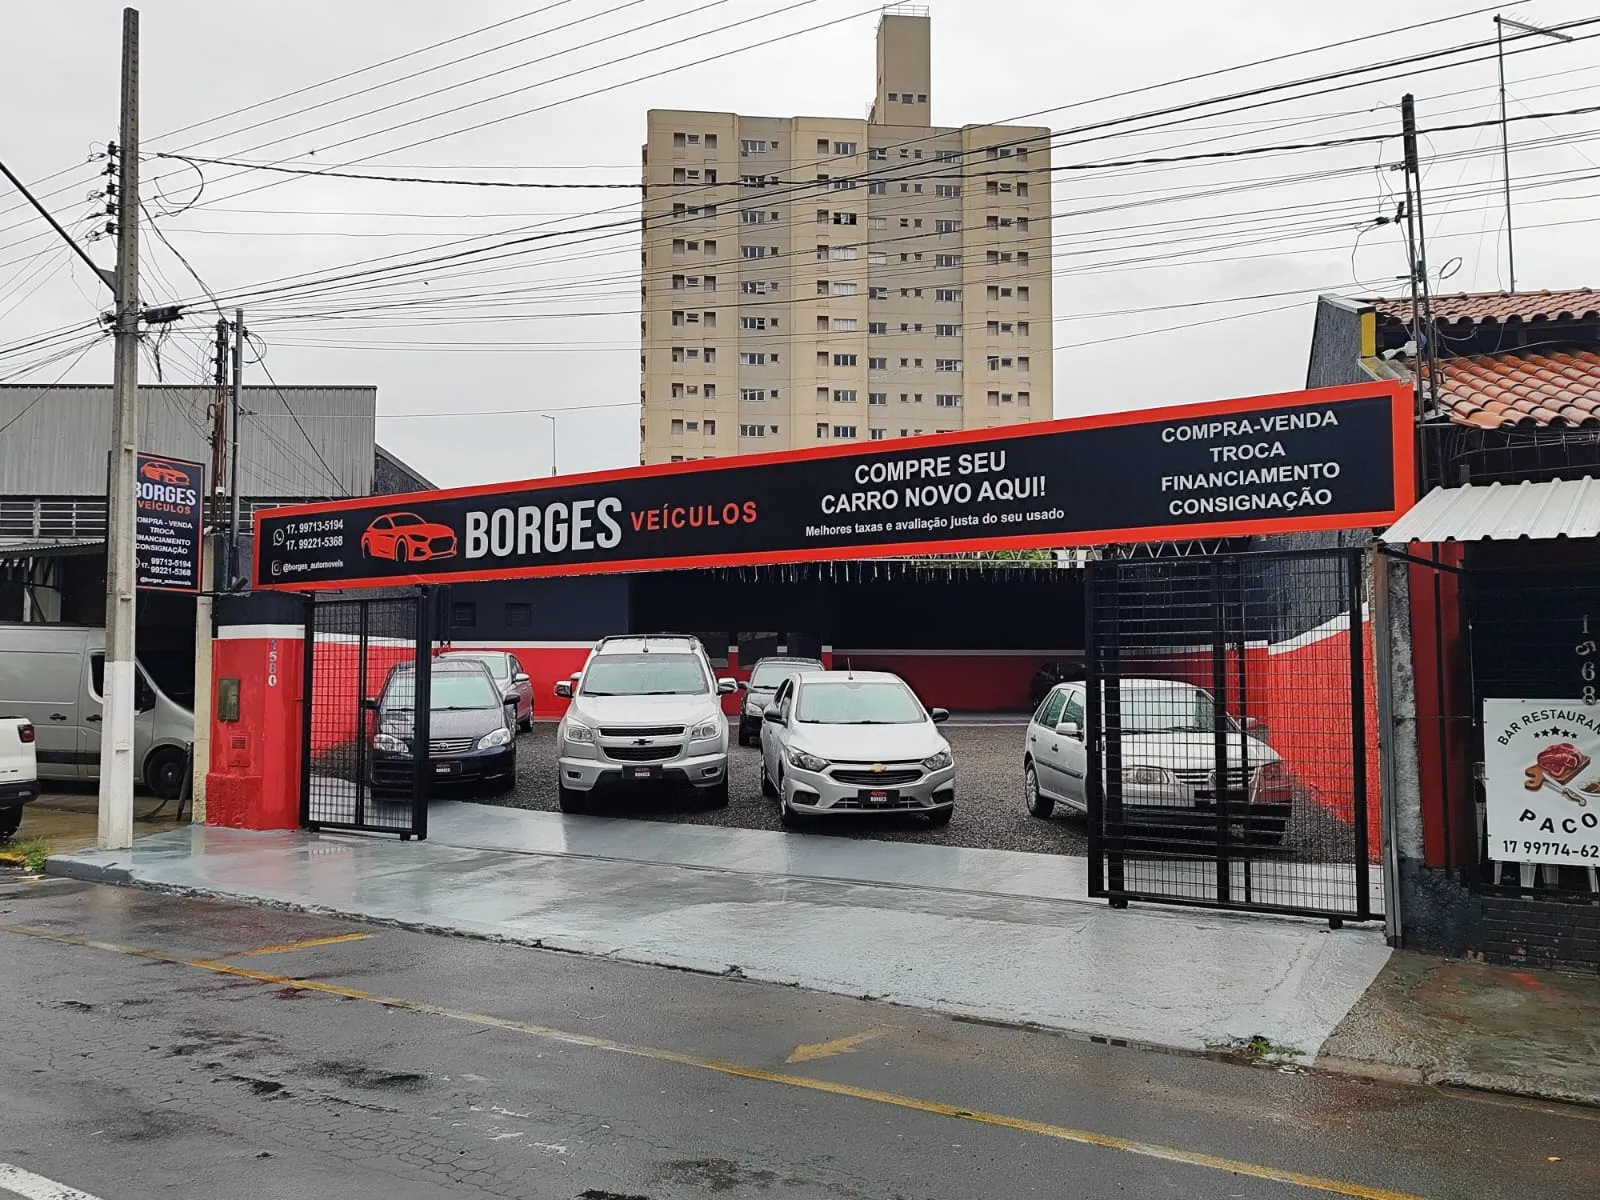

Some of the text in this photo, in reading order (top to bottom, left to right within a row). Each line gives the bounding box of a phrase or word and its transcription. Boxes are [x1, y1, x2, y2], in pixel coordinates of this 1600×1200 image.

[1161, 410, 1339, 443] COMPRA-VENDA
[1209, 441, 1286, 463] TROCA
[854, 450, 1006, 484] COMPRE SEU
[1161, 462, 1340, 492] FINANCIAMENTO
[821, 475, 1046, 514] CARRO NOVO AQUI!
[1169, 487, 1333, 516] CONSIGNAÇÃO
[136, 517, 163, 525] OMPRA
[169, 521, 193, 529] VENDA
[150, 527, 175, 535] TROCA
[299, 519, 343, 533] 99713-5194
[465, 496, 758, 559] BORGES VEÍCULOS
[805, 508, 1065, 537] Melhores taxas e avaliação justa do seu usado
[136, 534, 191, 546] INANCIAMENTO
[299, 535, 343, 550] 99221-5368
[1497, 722, 1522, 745] BAR
[1519, 808, 1598, 833] PACO
[1503, 840, 1600, 858] 17 99774-62
